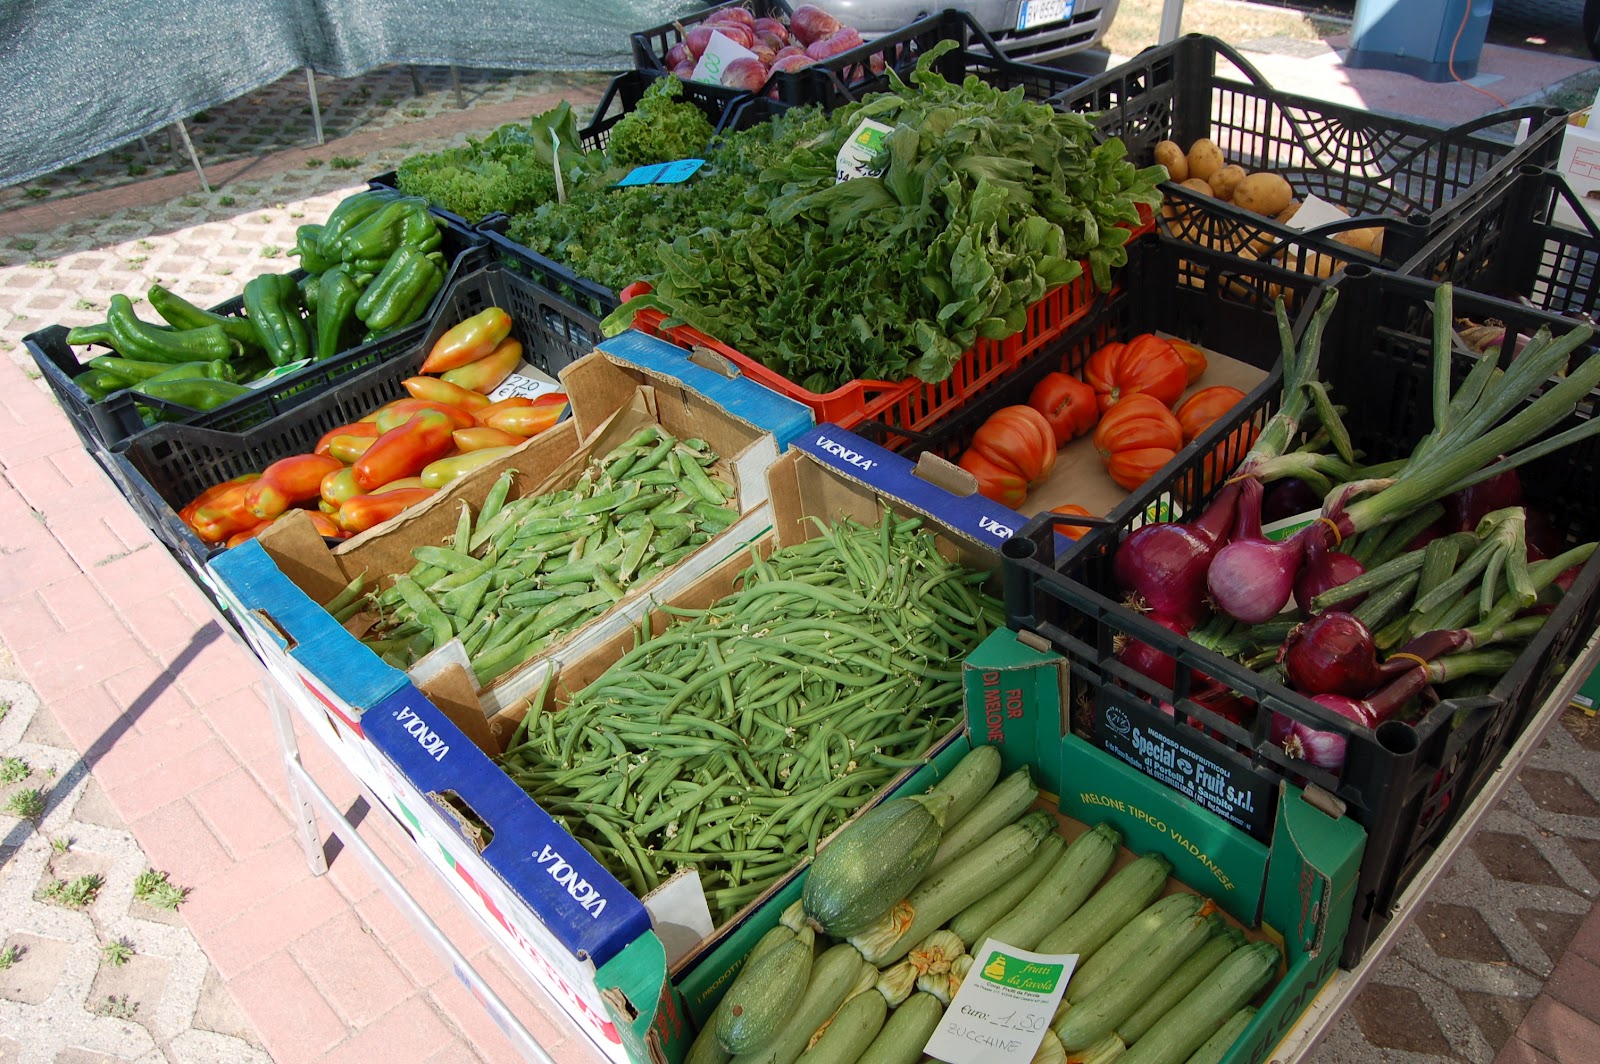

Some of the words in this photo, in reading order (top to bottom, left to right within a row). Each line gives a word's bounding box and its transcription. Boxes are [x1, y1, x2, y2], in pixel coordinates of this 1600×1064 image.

[815, 435, 872, 471] VIGNOLA
[982, 671, 999, 687] DI
[984, 689, 1005, 744] MELONE
[1005, 688, 1023, 720] FIOR
[396, 705, 450, 762] VIGNOLA
[1147, 727, 1179, 750] INGROSSO
[1179, 745, 1231, 779] ORTOFRUTTICOLI
[1132, 727, 1176, 769] Special
[1195, 763, 1226, 797] Fruit
[1226, 785, 1255, 814] s.r.l.
[1144, 757, 1153, 767] di
[1187, 780, 1195, 790] &
[1197, 786, 1234, 812] Sambito
[1080, 792, 1126, 813] MELONE
[1127, 804, 1167, 834] TIPICO
[1170, 828, 1235, 891] VIADANESE
[537, 843, 607, 919] VIGNOLA
[702, 959, 742, 999] PRODOTTI
[1006, 974, 1021, 986] da
[1017, 977, 1053, 991] favola
[1019, 962, 1052, 976] frutti
[947, 1022, 1023, 1053] ZUCCHINE
